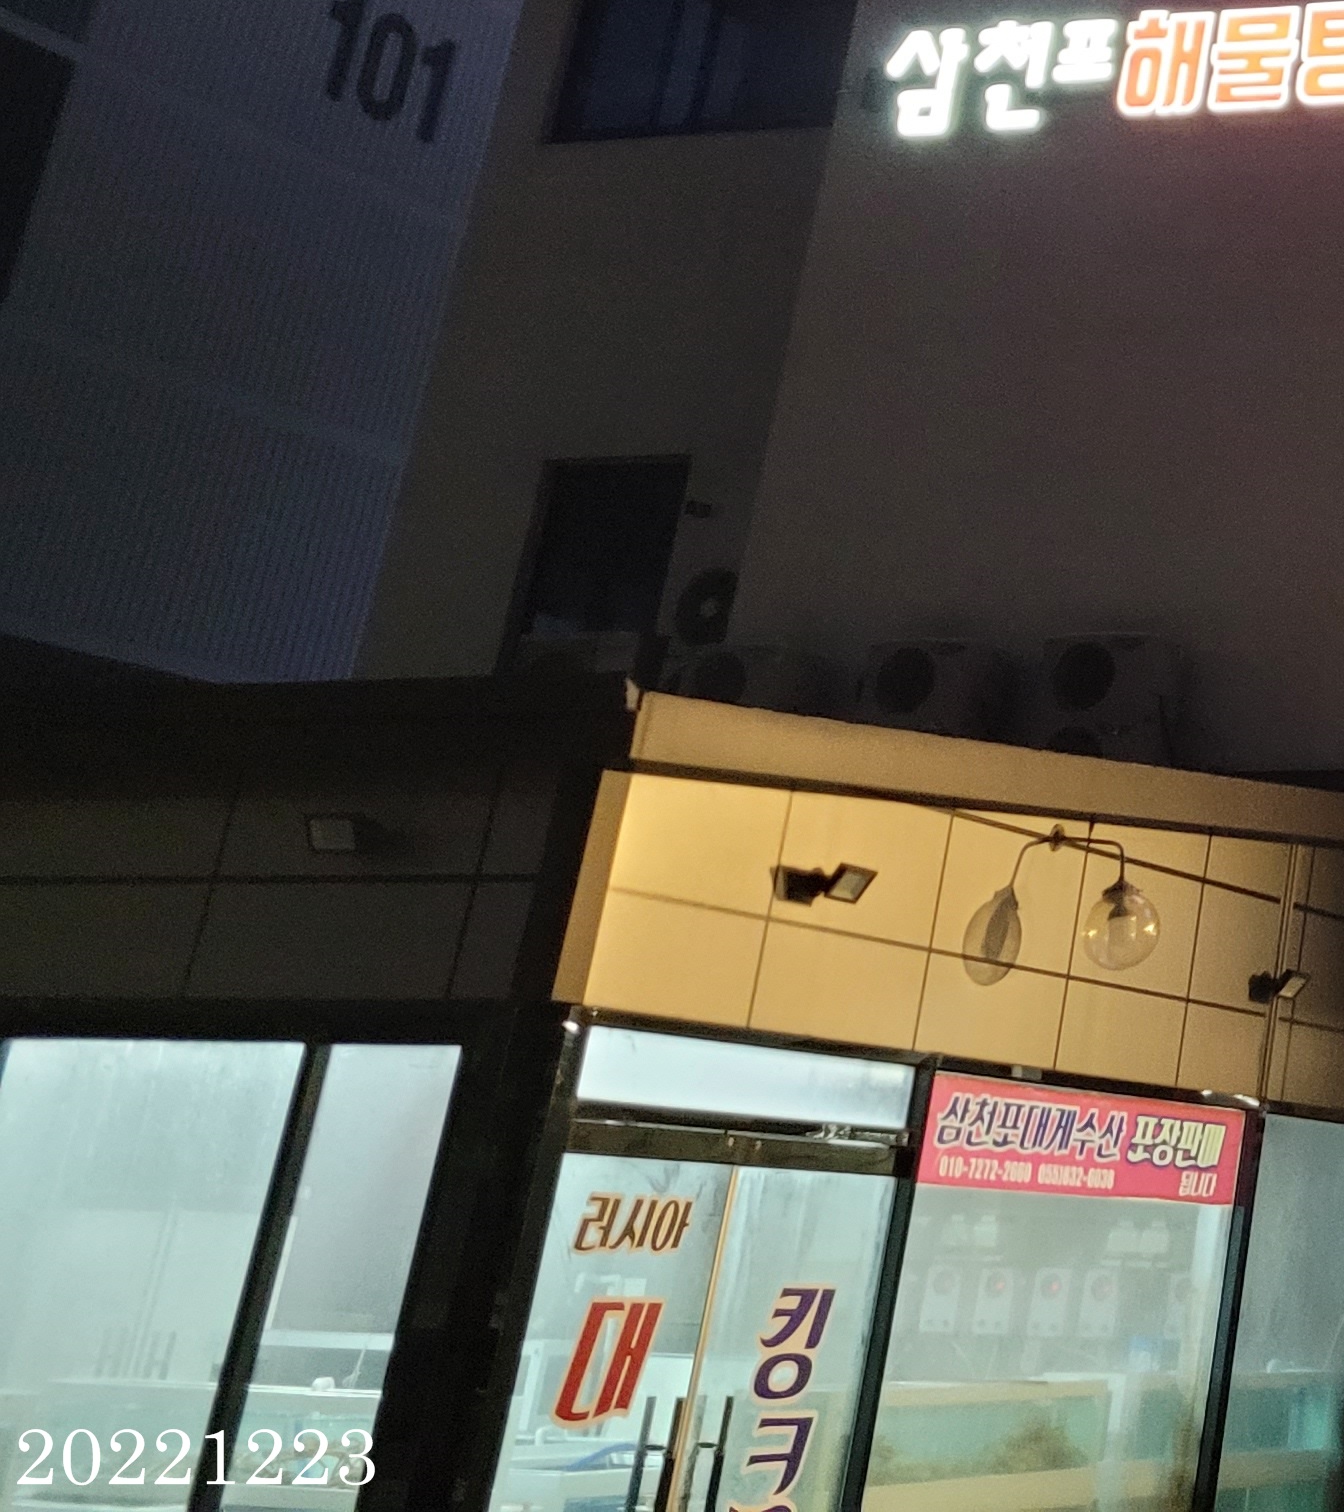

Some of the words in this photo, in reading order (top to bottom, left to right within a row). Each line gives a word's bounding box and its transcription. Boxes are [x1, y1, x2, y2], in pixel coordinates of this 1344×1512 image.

[884, 15, 1117, 137] 삼천포
[1126, 1114, 1226, 1168] 포장판매
[572, 1192, 694, 1253] 러시아
[552, 1297, 664, 1426] 대
